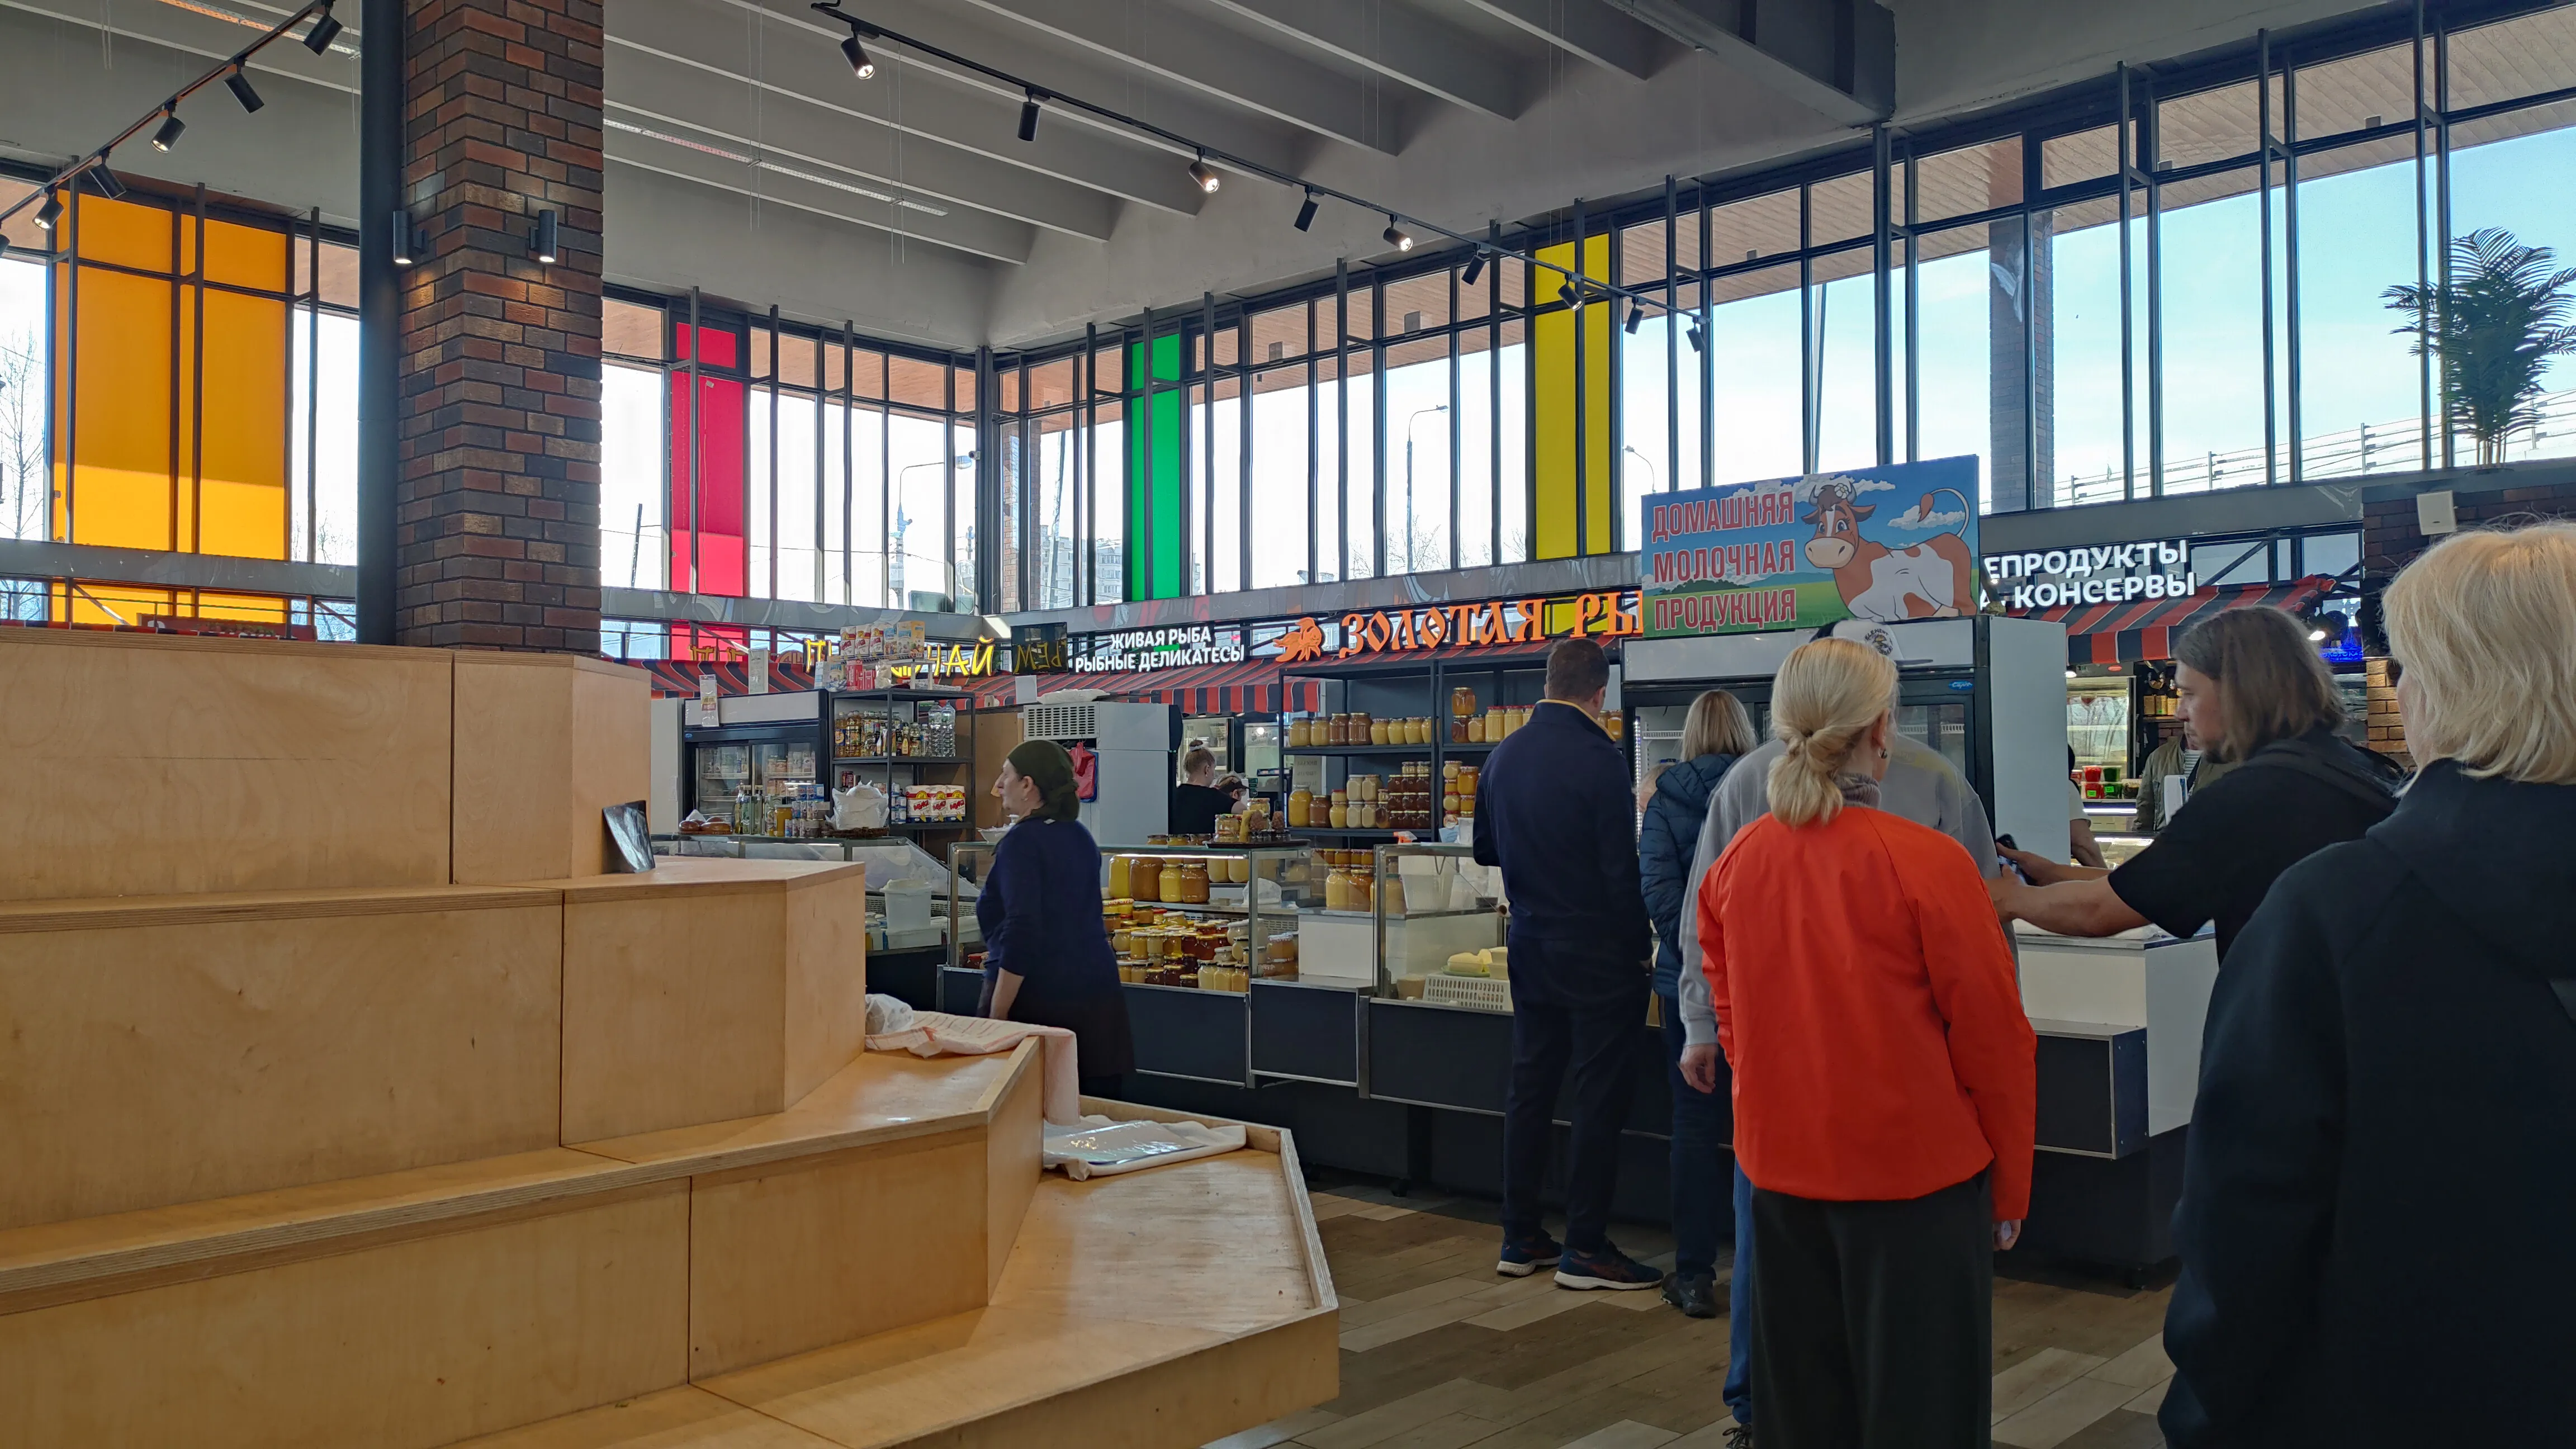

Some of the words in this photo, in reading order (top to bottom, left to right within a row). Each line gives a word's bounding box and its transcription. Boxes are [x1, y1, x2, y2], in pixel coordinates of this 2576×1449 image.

[1652, 491, 1794, 543] ДОМАШНЯЯ
[1653, 539, 1795, 584] МОЛОЧНАЯ
[1654, 588, 1796, 633] ПРОДУКЦИЯ
[2014, 572, 2195, 609] КОНСЕРВЫ
[1111, 629, 1165, 650] ЖИВАЯ
[1169, 626, 1211, 645] РЫБА
[1339, 598, 1546, 659] ЗОЛОТАЯ
[927, 635, 995, 678] ЧАЙ
[1075, 652, 1136, 673] РЫБНЫЕ
[1138, 644, 1244, 673] ДЕЛИКАТЕСЫ
